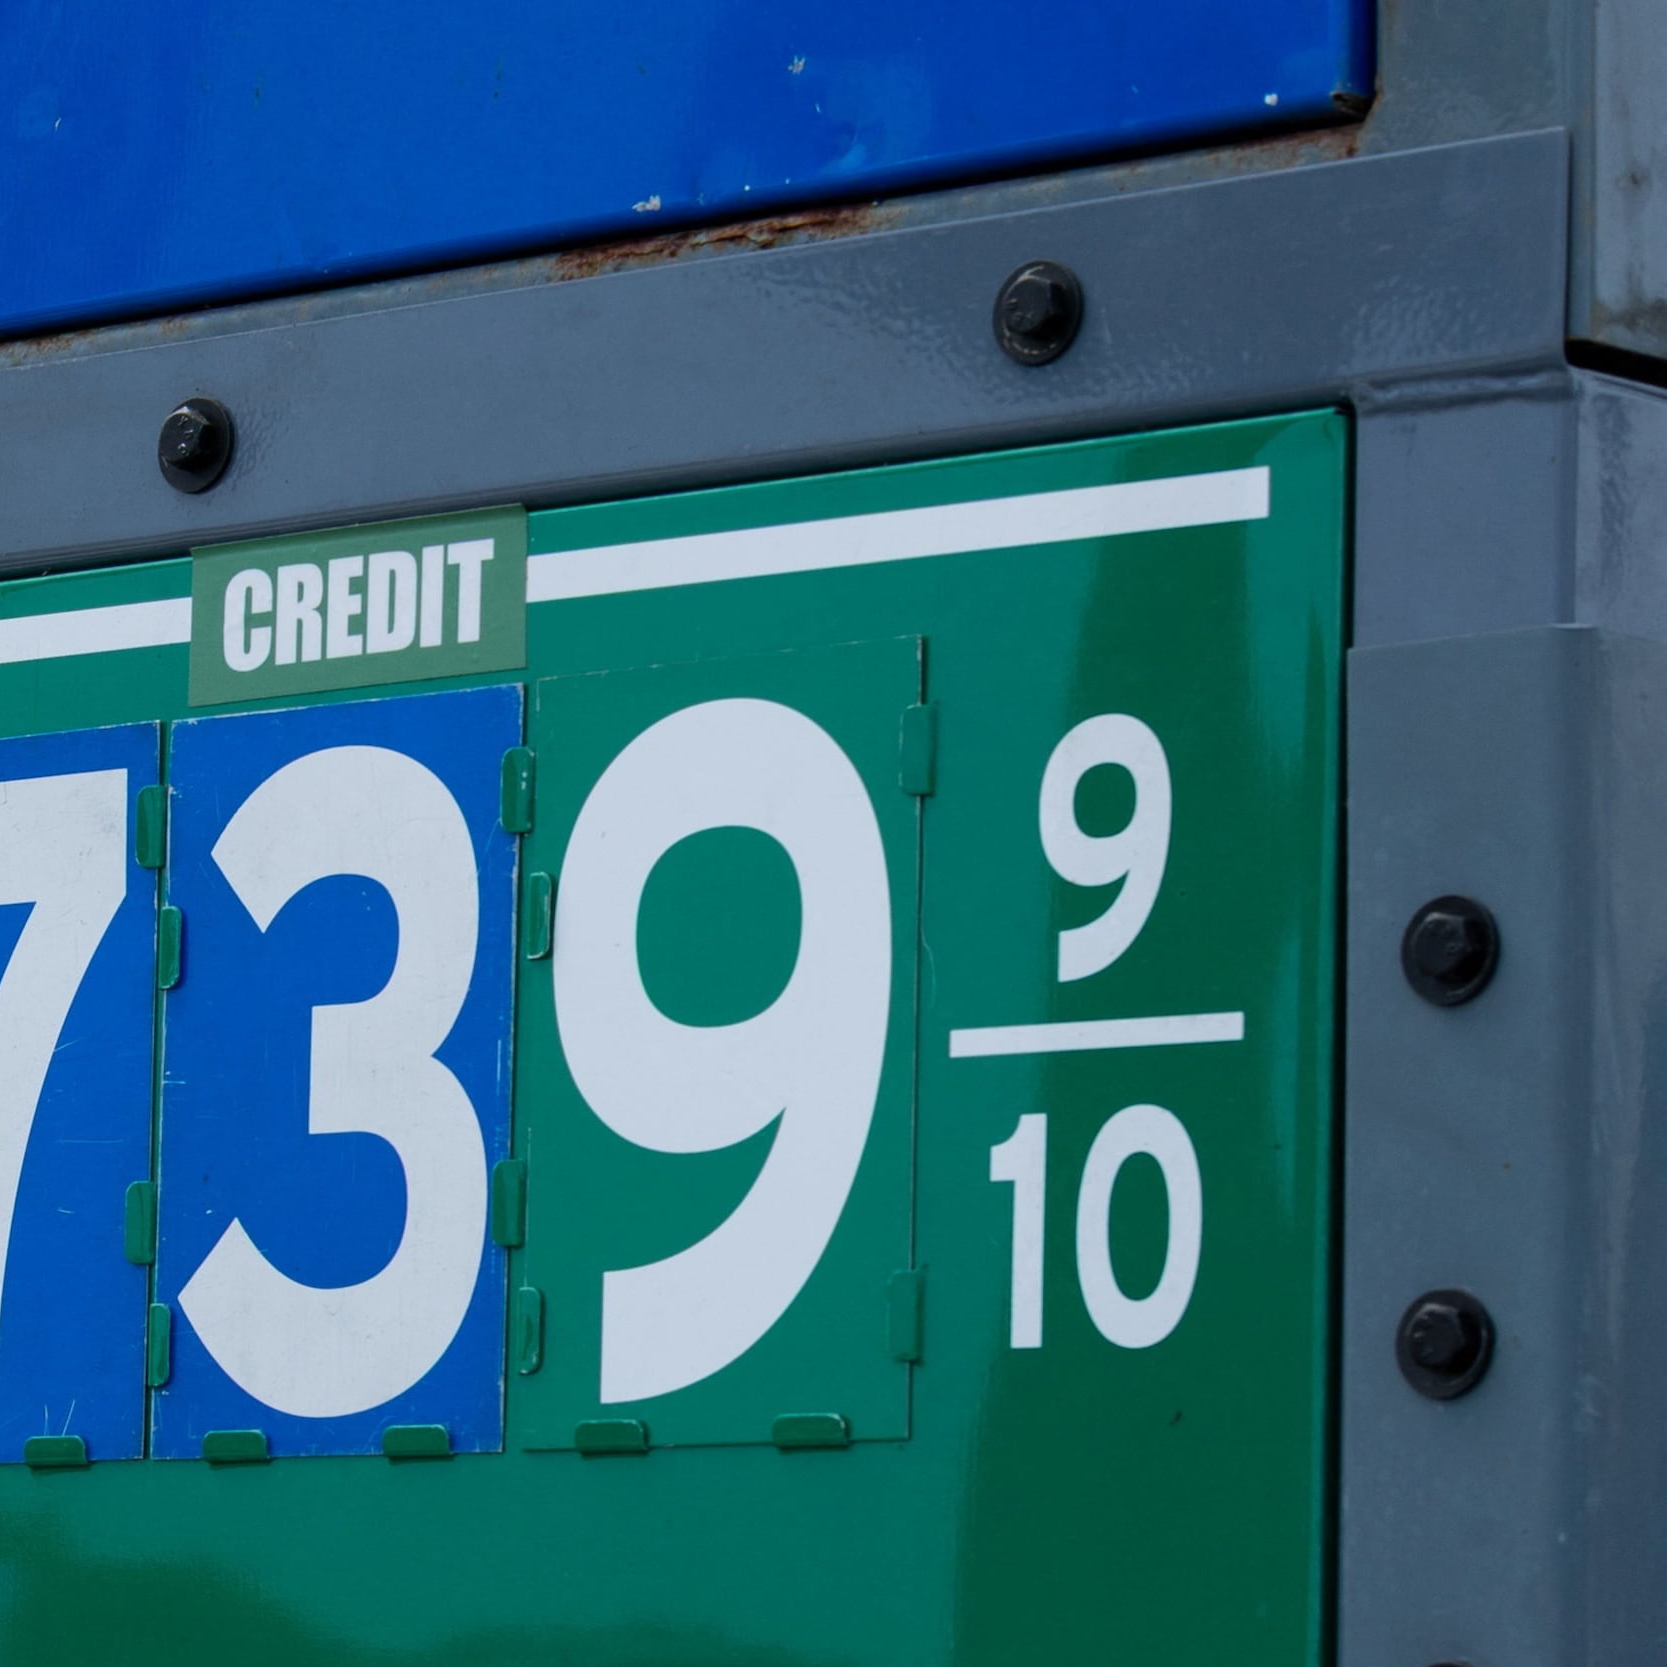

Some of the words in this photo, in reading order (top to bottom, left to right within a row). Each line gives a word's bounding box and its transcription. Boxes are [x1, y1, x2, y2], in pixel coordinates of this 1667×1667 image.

[222, 538, 496, 674] CREDIT
[1038, 713, 1173, 983] 9
[989, 1104, 1203, 1349] 10
